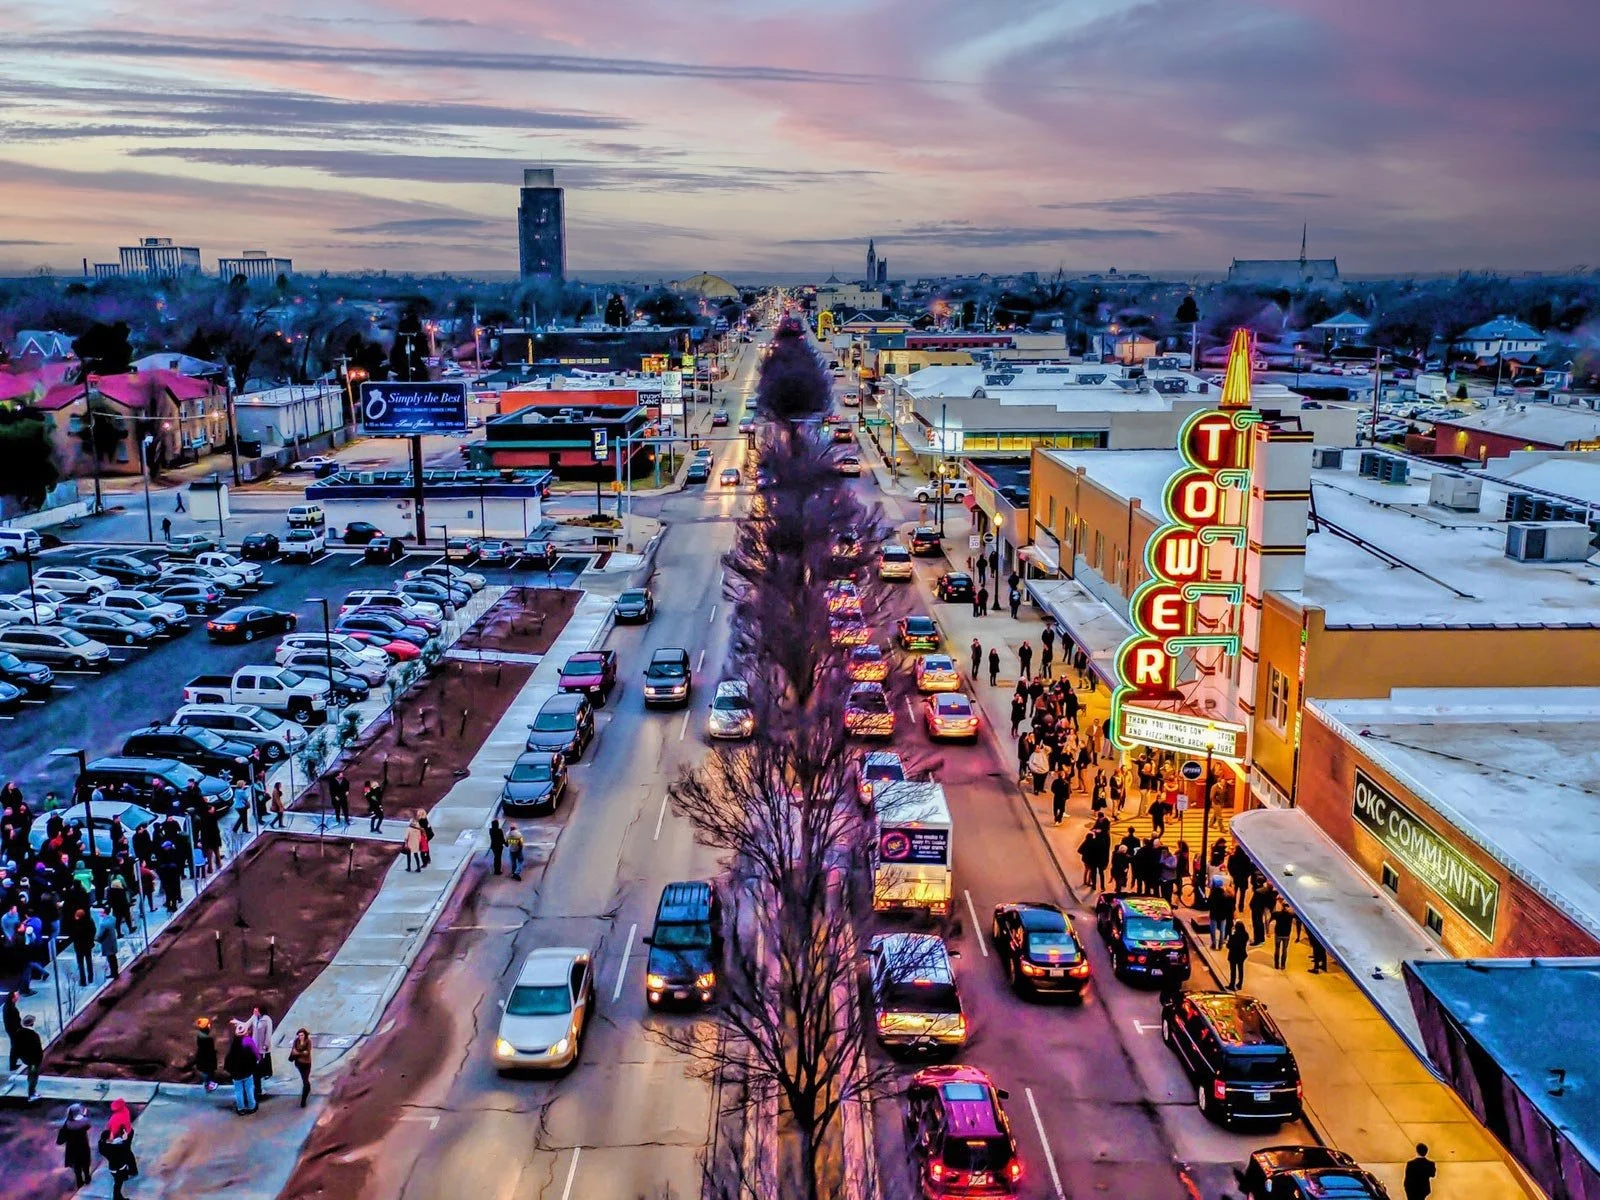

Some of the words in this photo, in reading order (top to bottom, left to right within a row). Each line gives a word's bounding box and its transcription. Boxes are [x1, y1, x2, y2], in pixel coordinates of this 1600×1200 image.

[388, 392, 422, 406] Simply
[423, 392, 439, 403] the
[440, 393, 461, 403] Best
[1135, 423, 1231, 685] TOWER
[1128, 715, 1148, 725] THANK
[1152, 720, 1164, 729] YOU
[1128, 727, 1142, 736] AND
[1356, 782, 1386, 826] OKC
[1389, 810, 1492, 917] COMMUNITY
